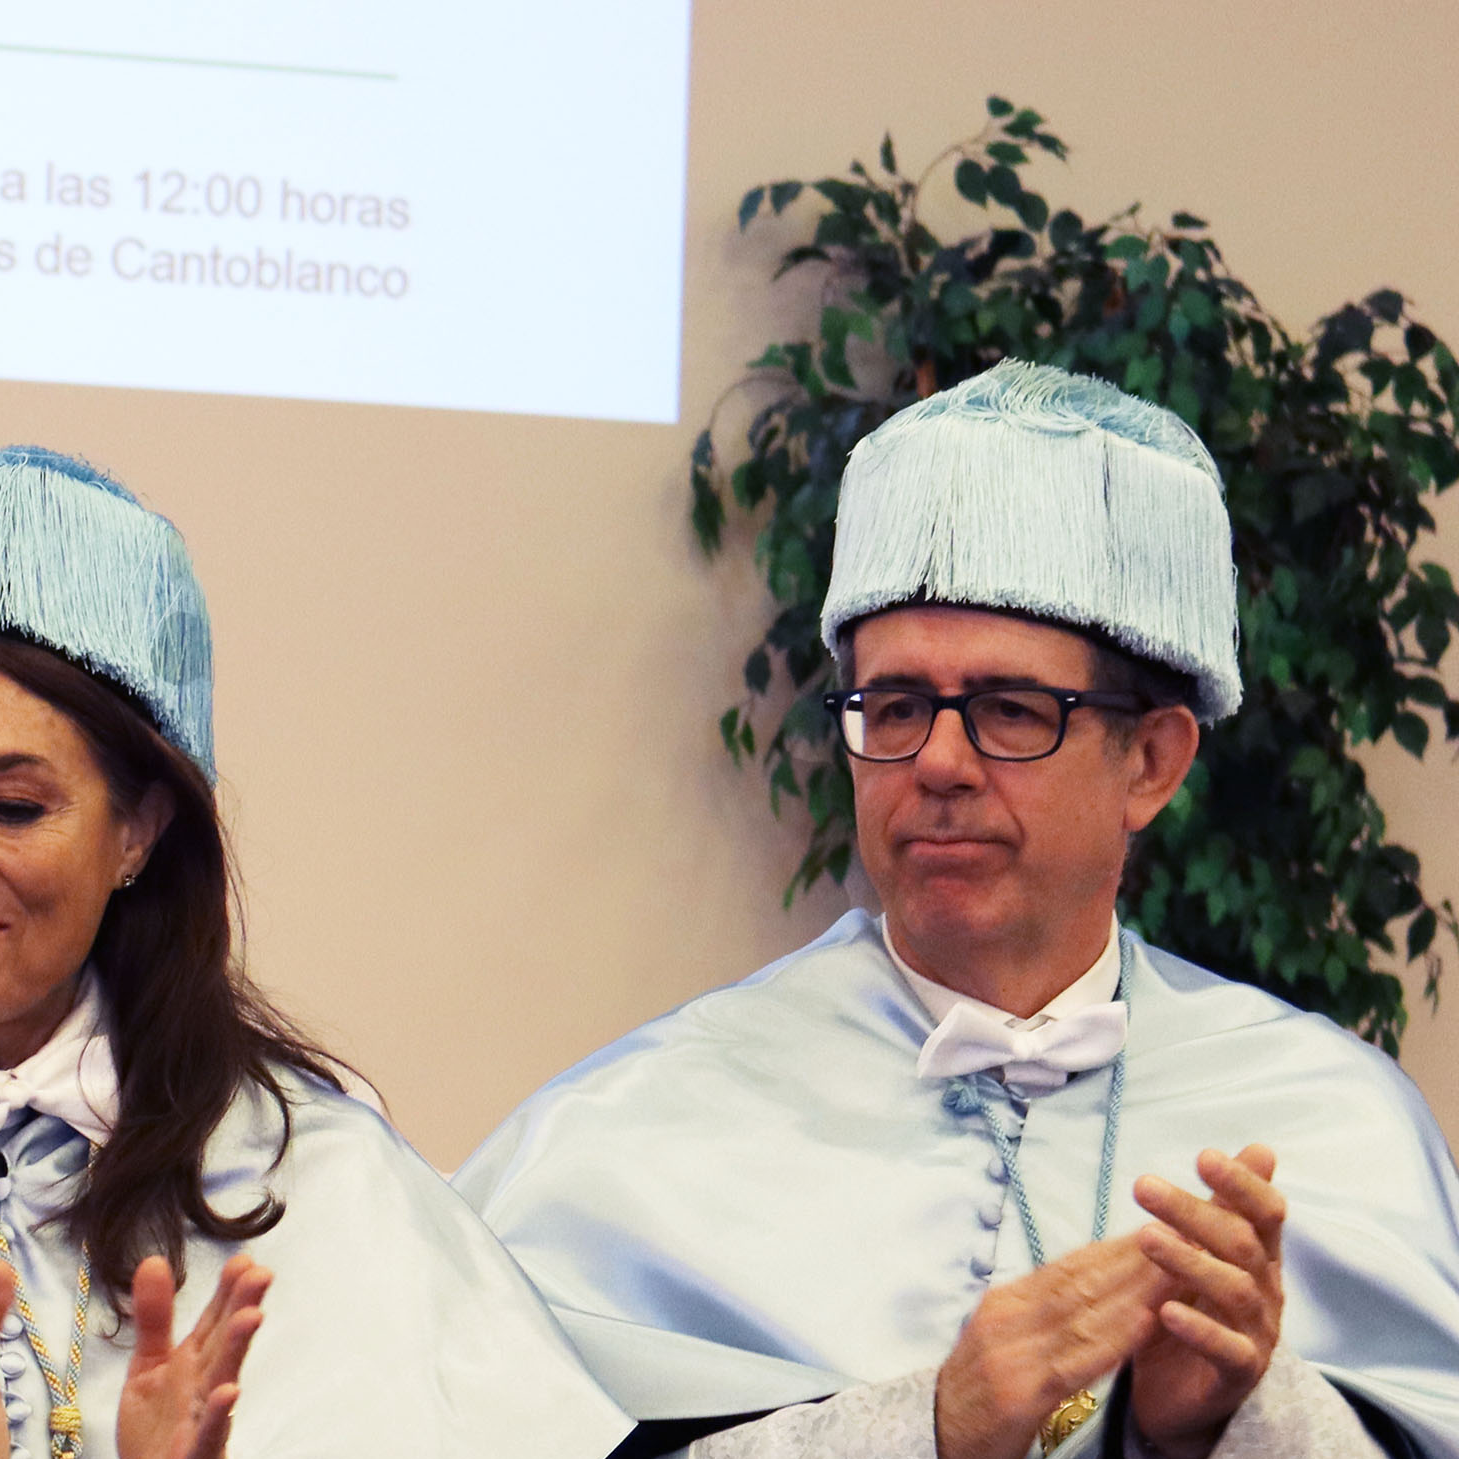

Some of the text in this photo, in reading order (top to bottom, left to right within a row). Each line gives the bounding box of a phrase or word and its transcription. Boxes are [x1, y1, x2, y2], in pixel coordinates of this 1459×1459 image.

[45, 160, 113, 210] las
[134, 168, 264, 221] 12:00
[279, 177, 412, 232] horas
[33, 232, 94, 279] de
[109, 235, 412, 300] Cantoblanco
